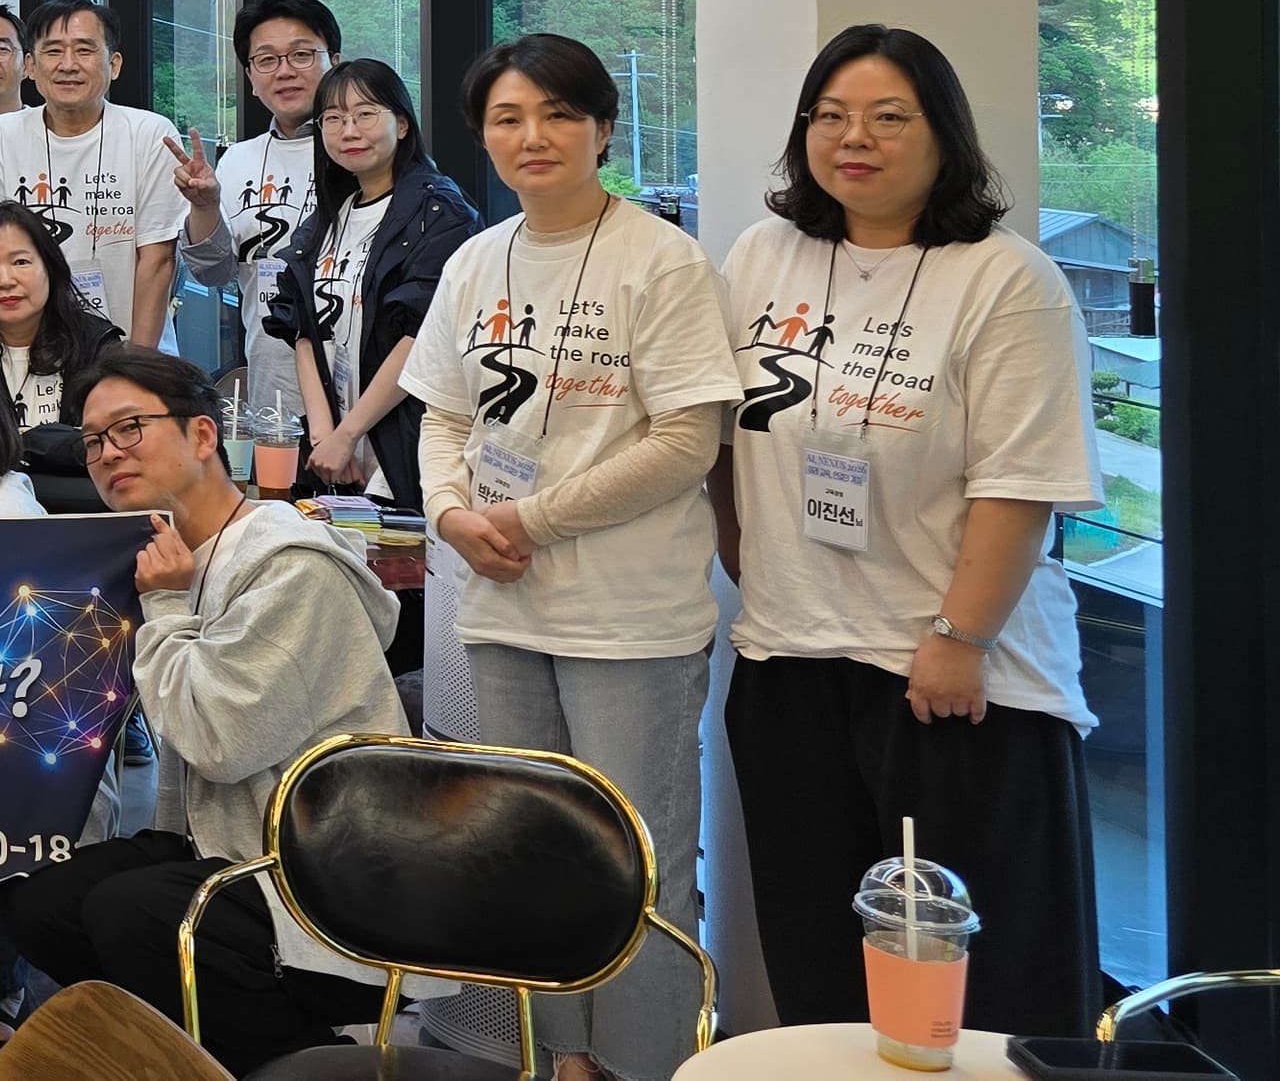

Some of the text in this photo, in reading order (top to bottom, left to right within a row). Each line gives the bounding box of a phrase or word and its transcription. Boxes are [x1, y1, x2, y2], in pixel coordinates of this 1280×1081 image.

[85, 172, 117, 184] Let's
[85, 188, 122, 200] make
[85, 205, 134, 216] the roa
[85, 218, 136, 242] togethe
[559, 299, 605, 316] Let's
[553, 323, 609, 341] make
[863, 316, 914, 338] Let's
[550, 344, 630, 368] the road
[852, 342, 911, 362] make
[841, 361, 935, 392] the road
[828, 384, 925, 422] together
